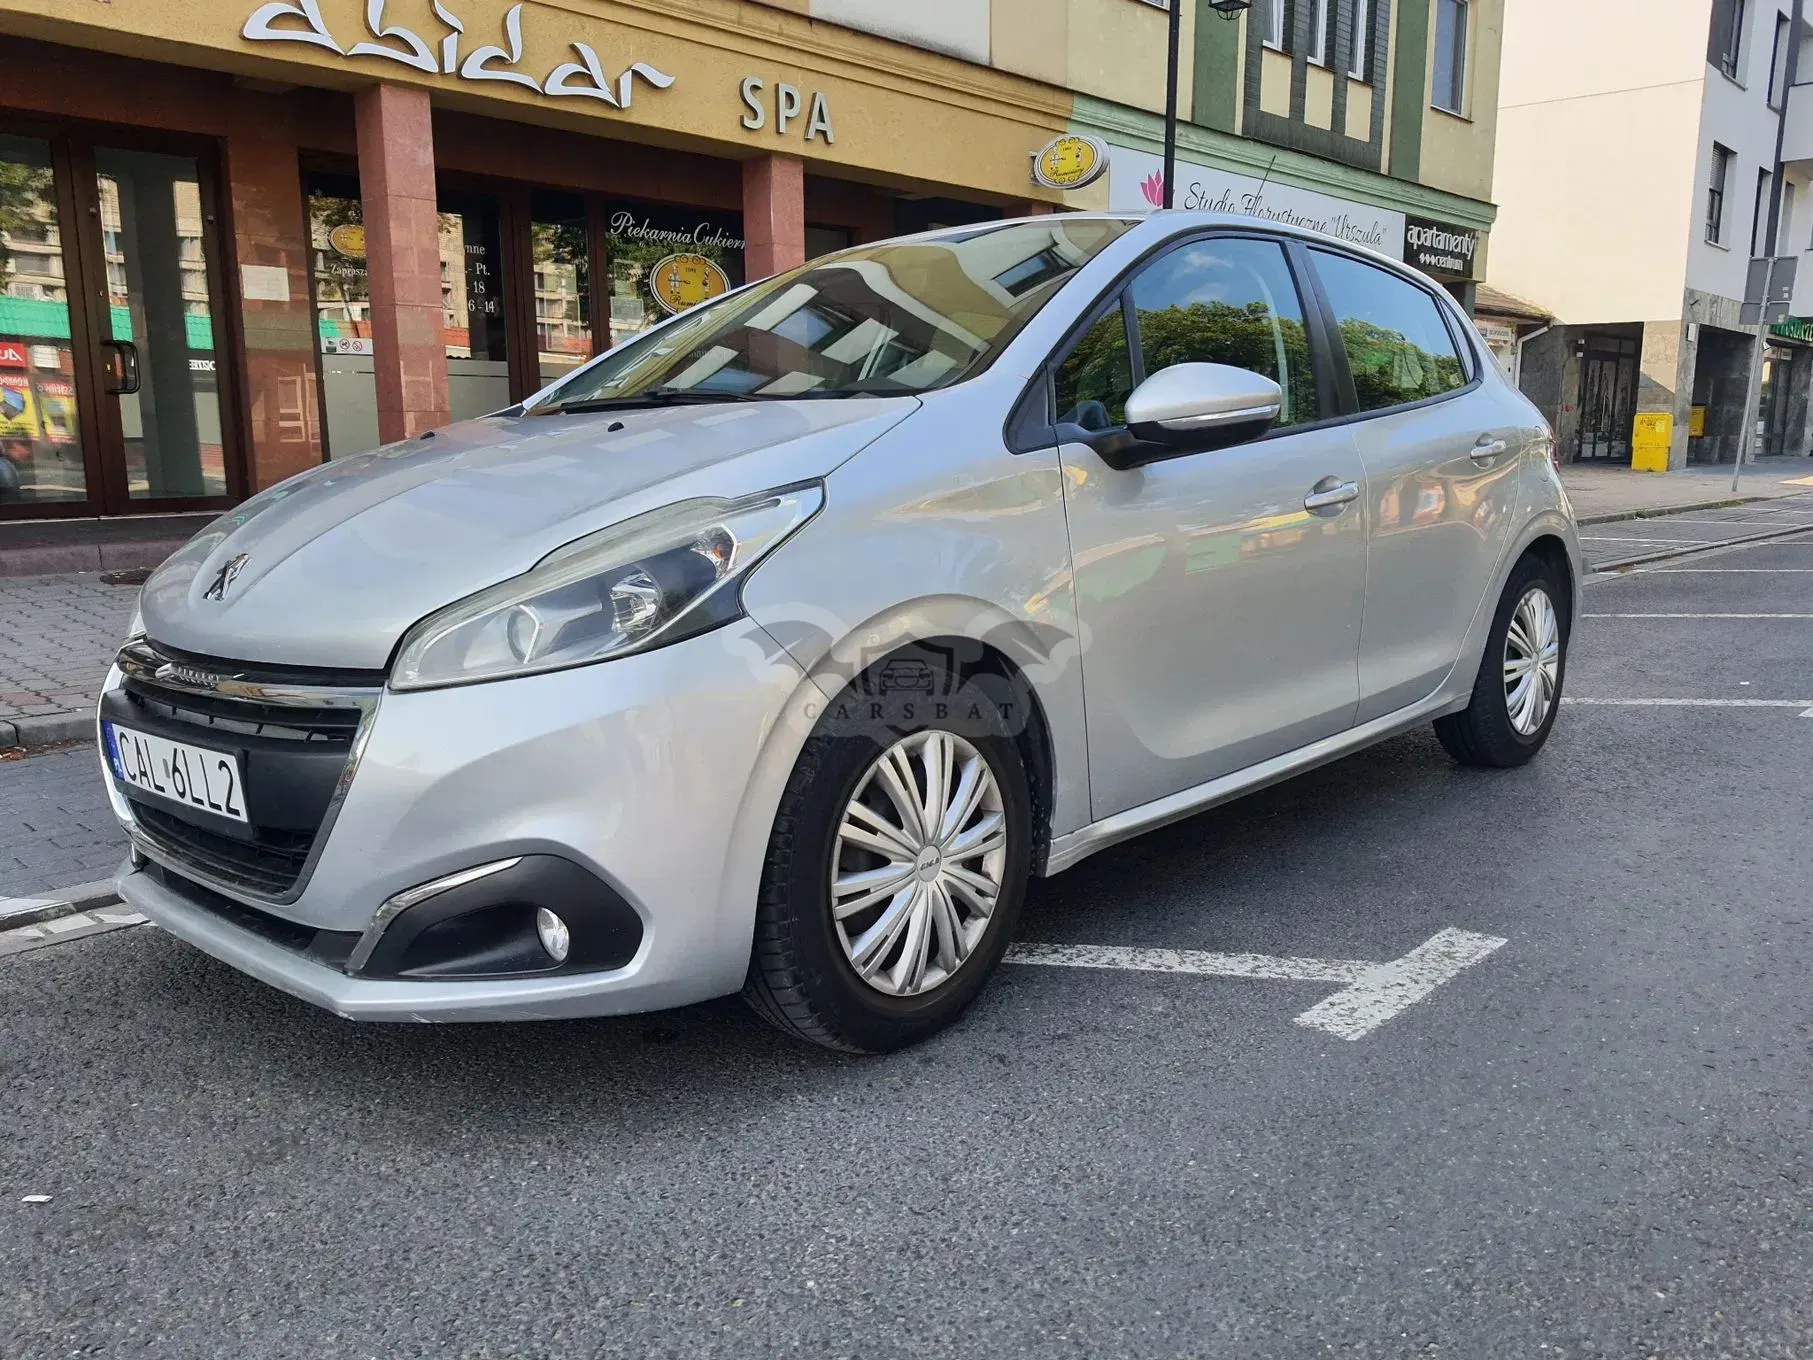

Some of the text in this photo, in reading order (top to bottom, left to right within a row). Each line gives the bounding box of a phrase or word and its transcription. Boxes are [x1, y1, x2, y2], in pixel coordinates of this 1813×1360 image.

[740, 76, 835, 144] SPA
[1184, 182, 1235, 211] Studio
[610, 211, 692, 244] Piekarnia
[1407, 225, 1475, 260] apartamenty
[475, 262, 490, 275] Pt.
[1435, 255, 1463, 271] centrum
[473, 281, 485, 293] 18
[484, 301, 495, 313] 14
[119, 731, 241, 817] CAL 6LL2
